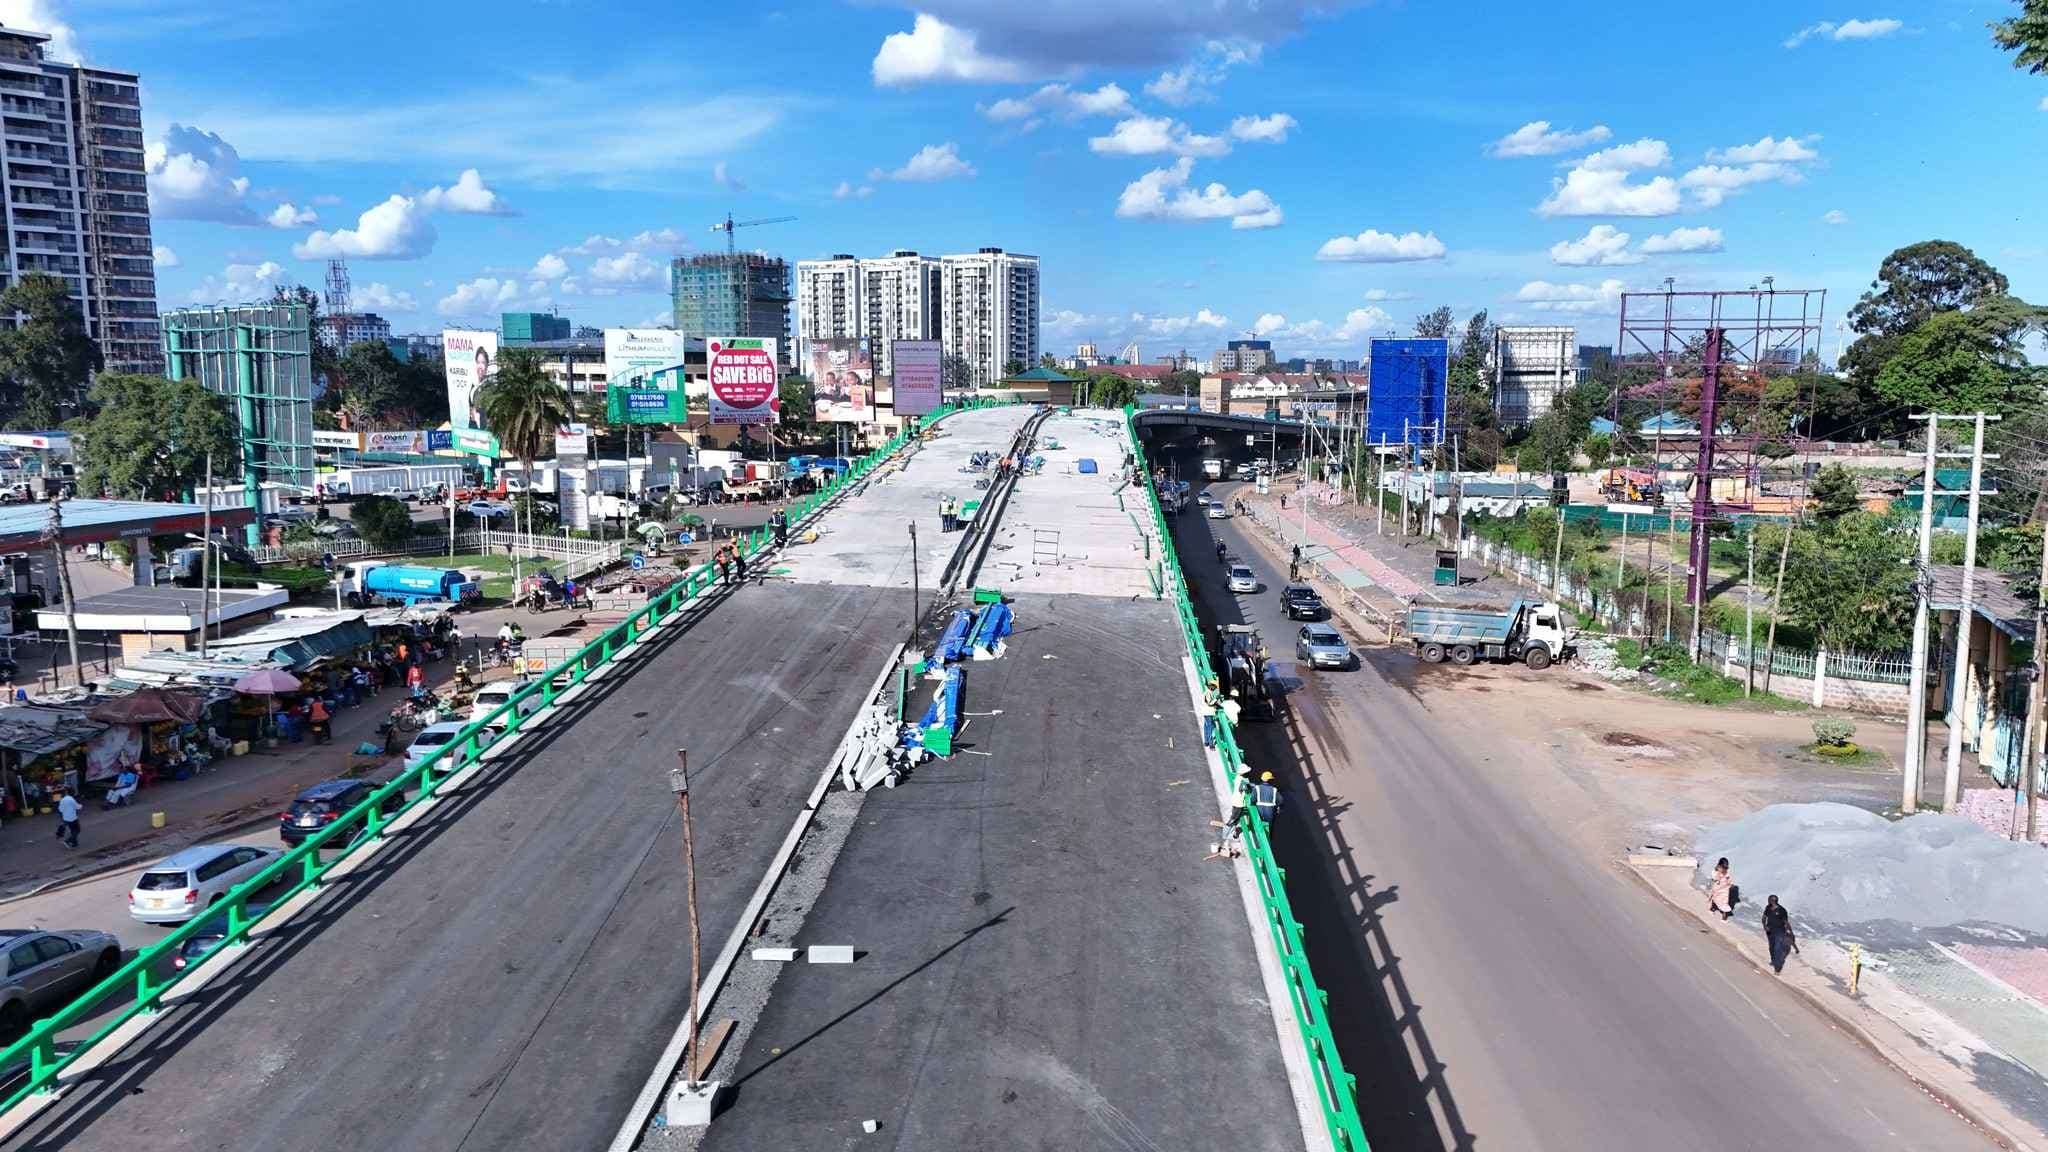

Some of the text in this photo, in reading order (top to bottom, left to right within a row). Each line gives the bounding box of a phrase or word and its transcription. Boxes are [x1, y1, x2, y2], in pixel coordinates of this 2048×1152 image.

[448, 338, 473, 352] MAMA
[718, 355, 768, 364] RED DOT SALE
[713, 366, 746, 384] SAVE
